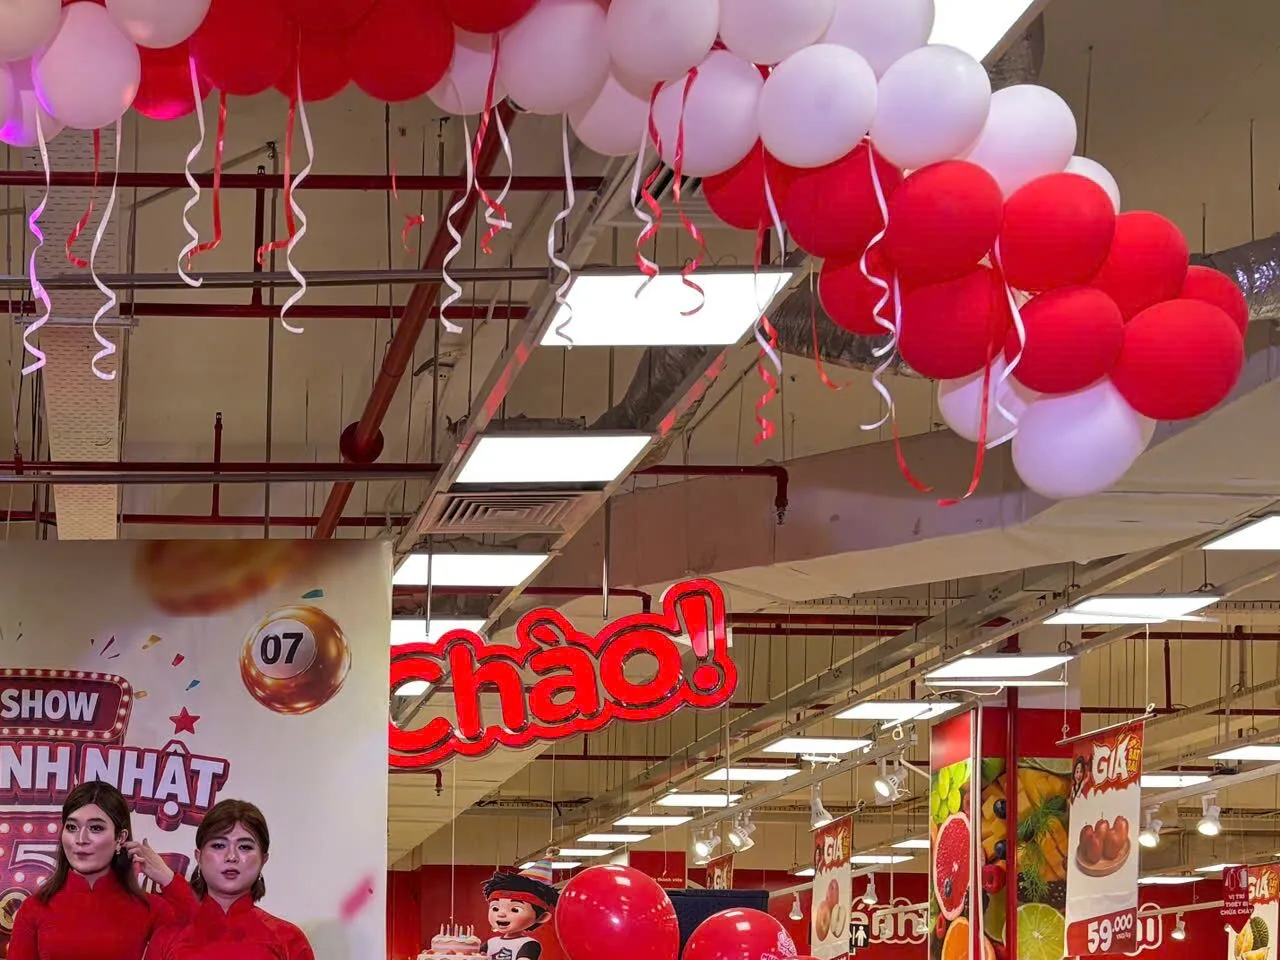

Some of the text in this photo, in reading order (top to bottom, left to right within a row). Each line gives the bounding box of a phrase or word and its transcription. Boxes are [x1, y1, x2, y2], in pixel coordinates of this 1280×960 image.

[259, 632, 306, 667] 07
[0, 688, 99, 722] SHOW
[82, 740, 226, 818] NHẬT
[1091, 735, 1130, 785] GIÁ
[1087, 913, 1133, 953] 59.000
